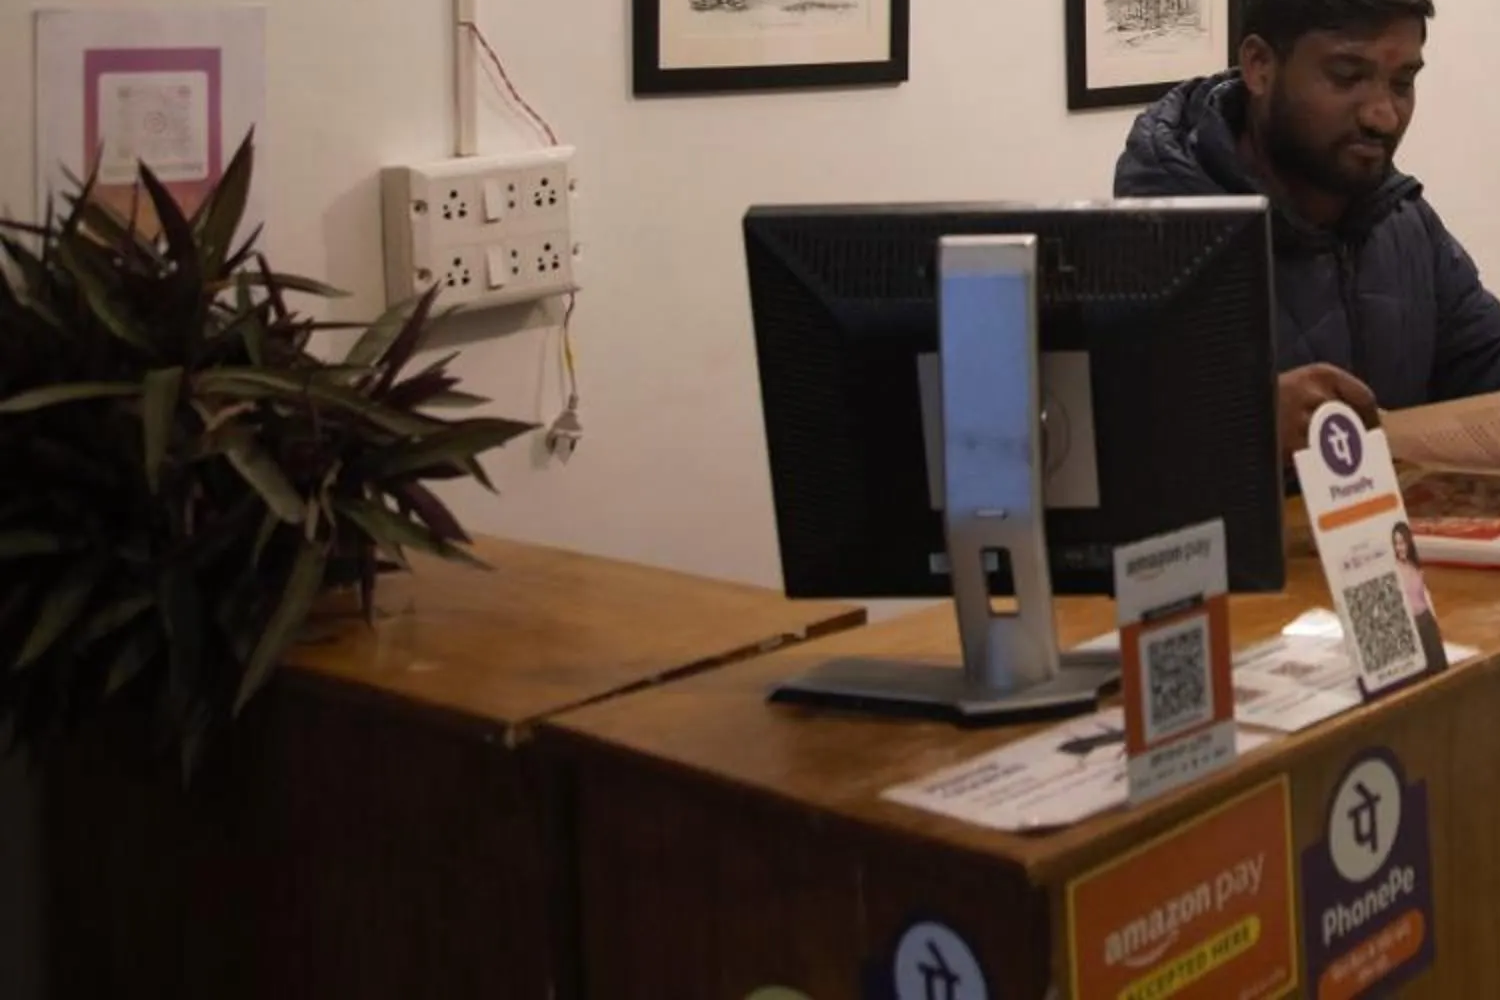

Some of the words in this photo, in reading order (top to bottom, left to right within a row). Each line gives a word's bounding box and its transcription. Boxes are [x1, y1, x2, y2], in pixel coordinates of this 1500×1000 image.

[1105, 883, 1212, 966] amazon
[1215, 853, 1266, 912] pay
[1321, 865, 1415, 946] PhonePe
